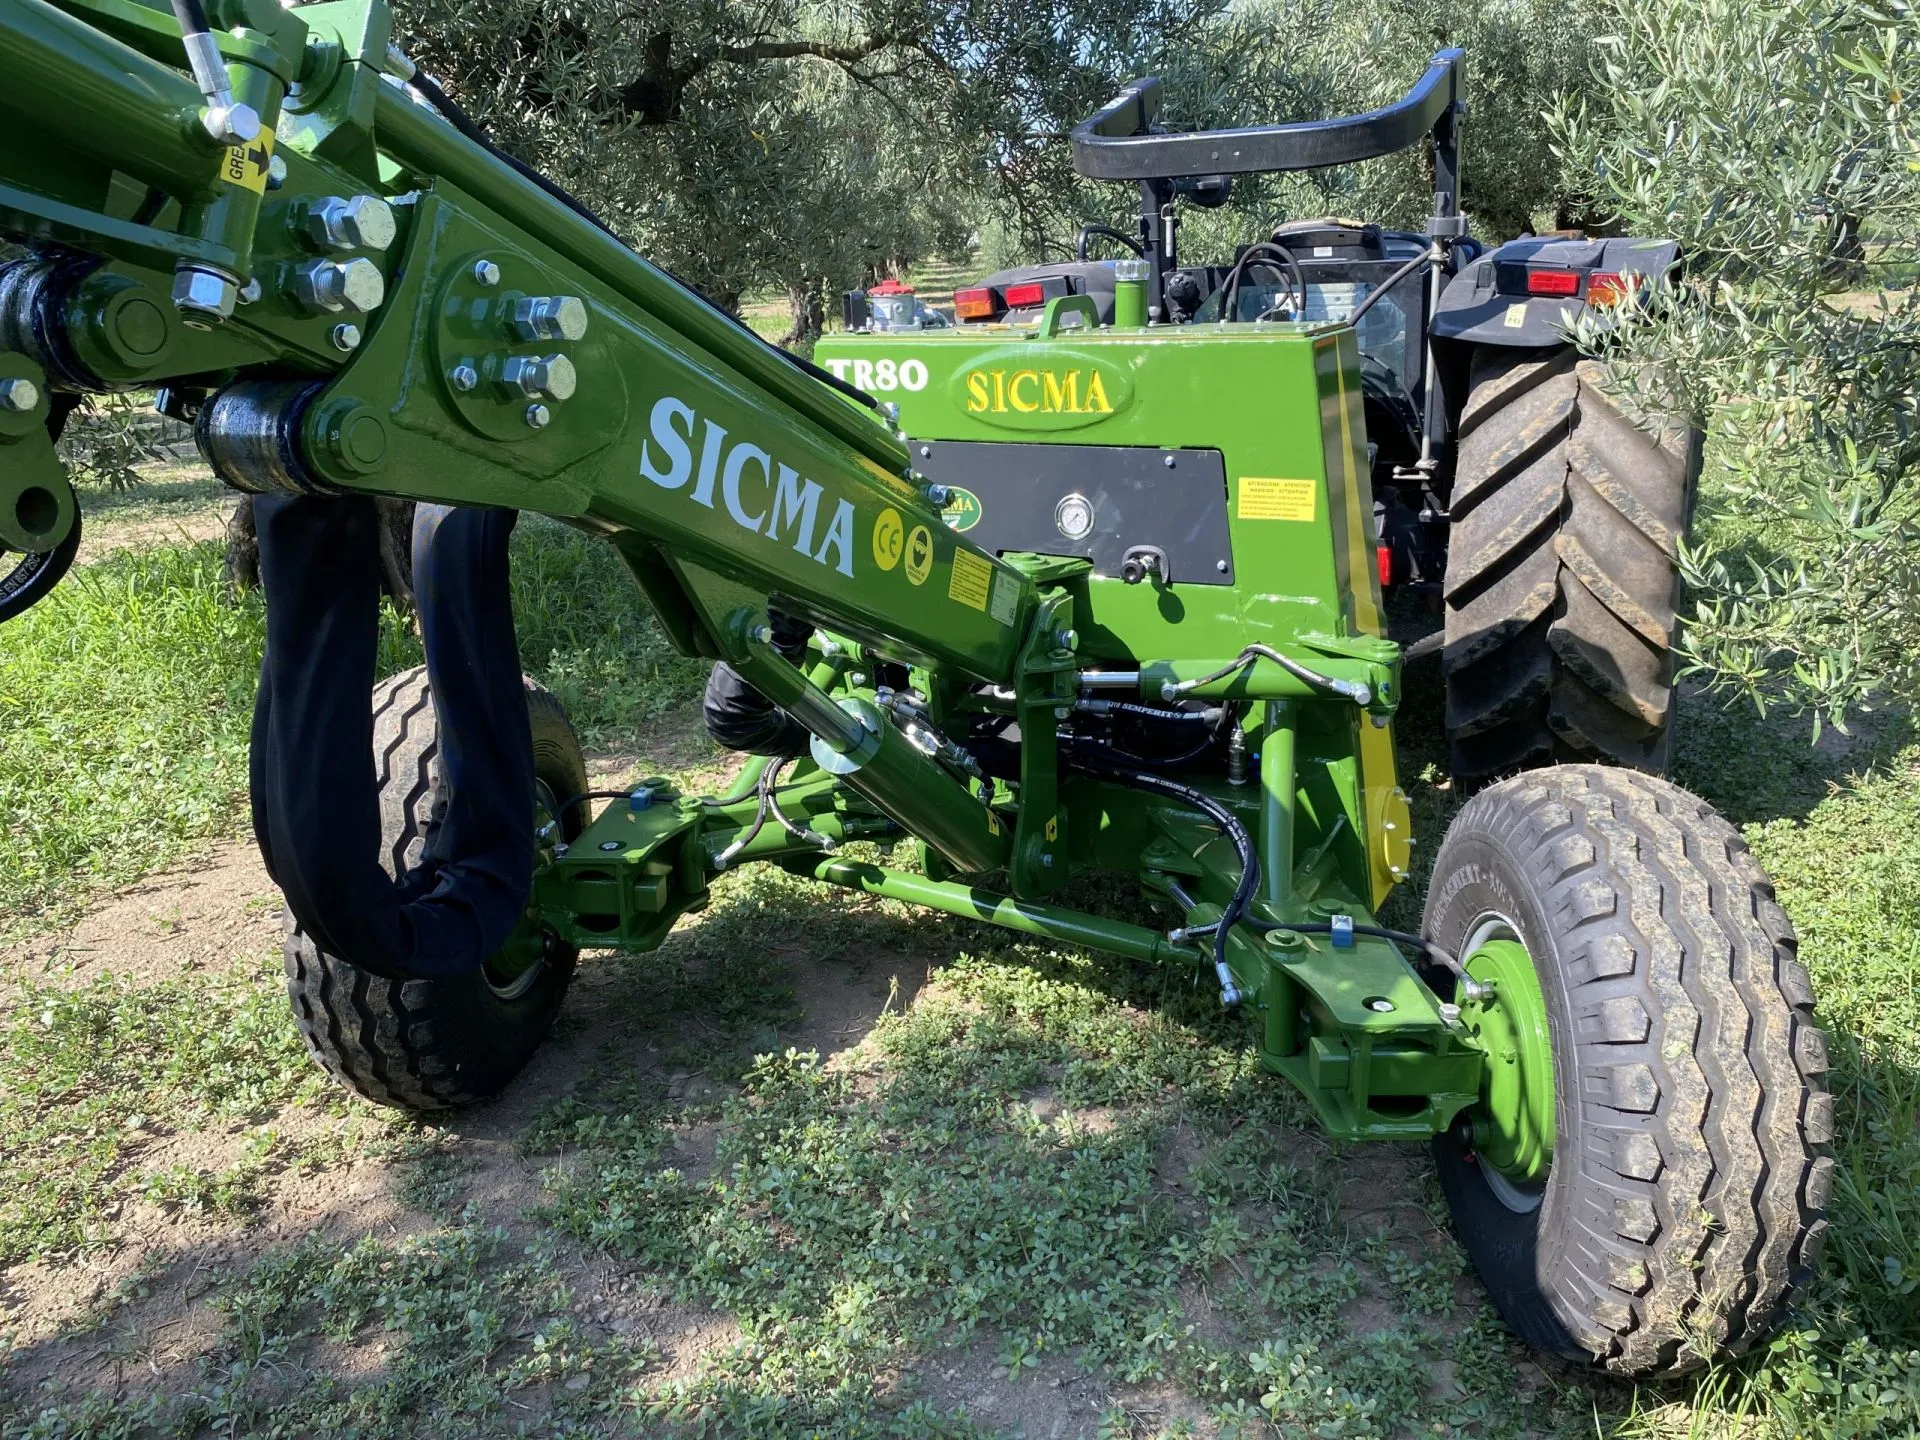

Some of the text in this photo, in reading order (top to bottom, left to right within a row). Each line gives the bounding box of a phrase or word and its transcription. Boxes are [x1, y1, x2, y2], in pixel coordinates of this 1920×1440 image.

[825, 358, 929, 391] TR80
[967, 368, 1114, 413] SICMA
[640, 397, 855, 578] SICMA
[1121, 703, 1174, 718] SEMPERIT
